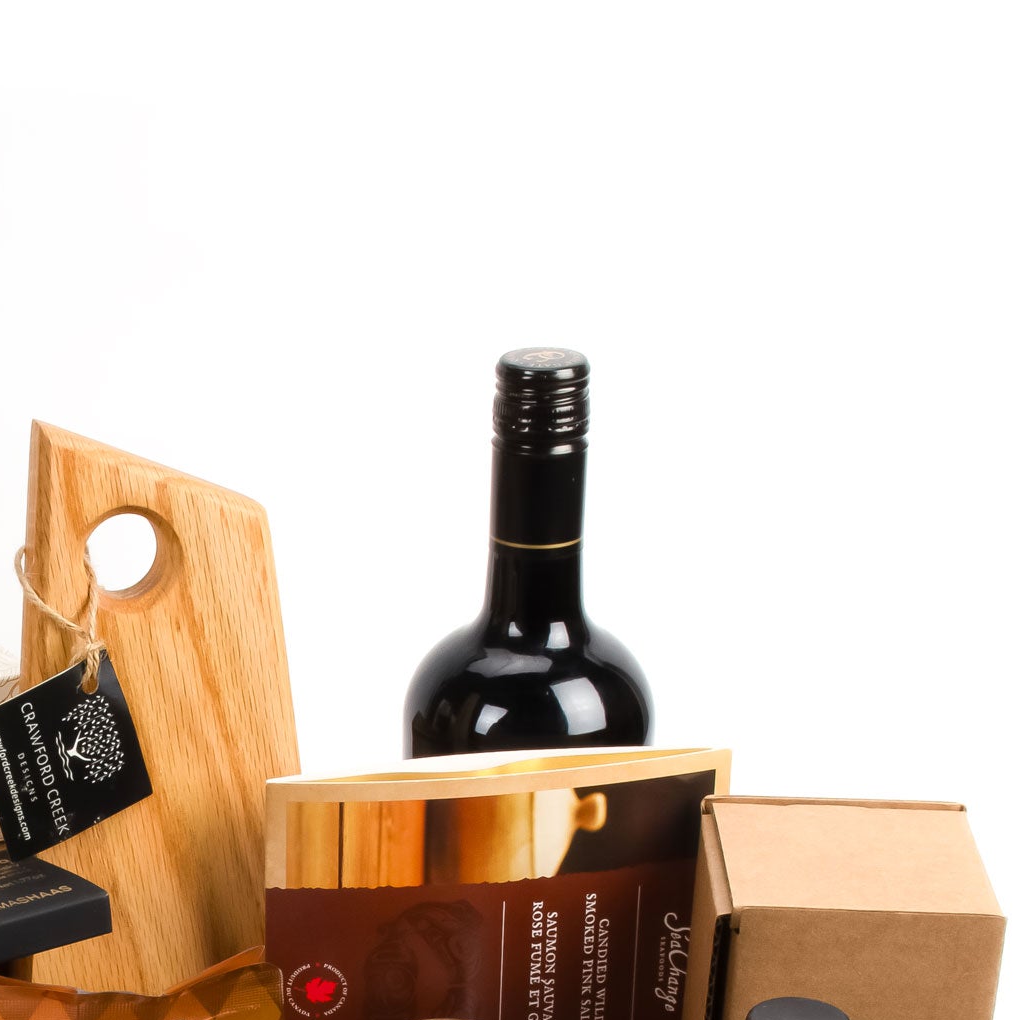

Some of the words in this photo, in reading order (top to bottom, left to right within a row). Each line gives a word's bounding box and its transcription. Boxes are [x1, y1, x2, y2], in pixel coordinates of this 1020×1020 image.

[17, 752, 38, 803] DESIGNS
[20, 702, 55, 787] CRAWFORD
[46, 788, 70, 836] CREEK
[531, 901, 544, 938] ROSE
[583, 893, 597, 955] SMOKED
[545, 911, 558, 974] SAUMON
[596, 918, 610, 984] CANDIED
[287, 963, 311, 986] PRODUIT
[323, 963, 348, 986] PRODUCT
[581, 960, 594, 994] PINK
[288, 997, 310, 1017] CANADA
[323, 997, 346, 1016] CANADA
[529, 990, 540, 1007] ET
